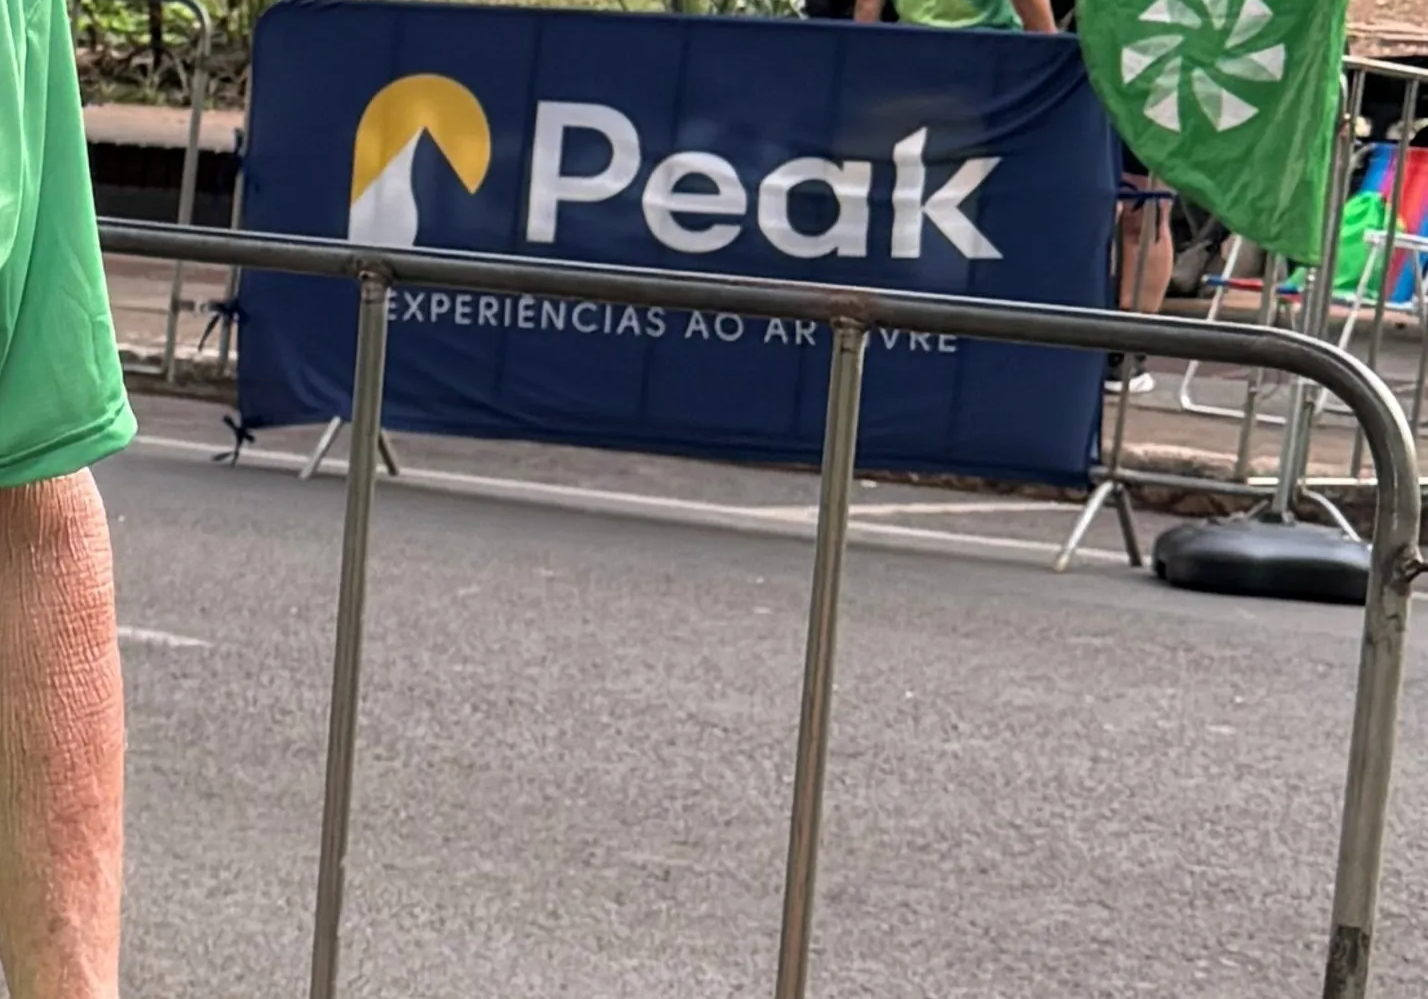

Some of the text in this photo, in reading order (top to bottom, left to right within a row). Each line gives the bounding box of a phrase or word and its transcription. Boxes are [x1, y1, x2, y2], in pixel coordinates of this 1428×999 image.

[526, 99, 1004, 260] Peak
[684, 309, 745, 342] AO
[763, 317, 817, 346] AR
[866, 327, 958, 352] VRE
